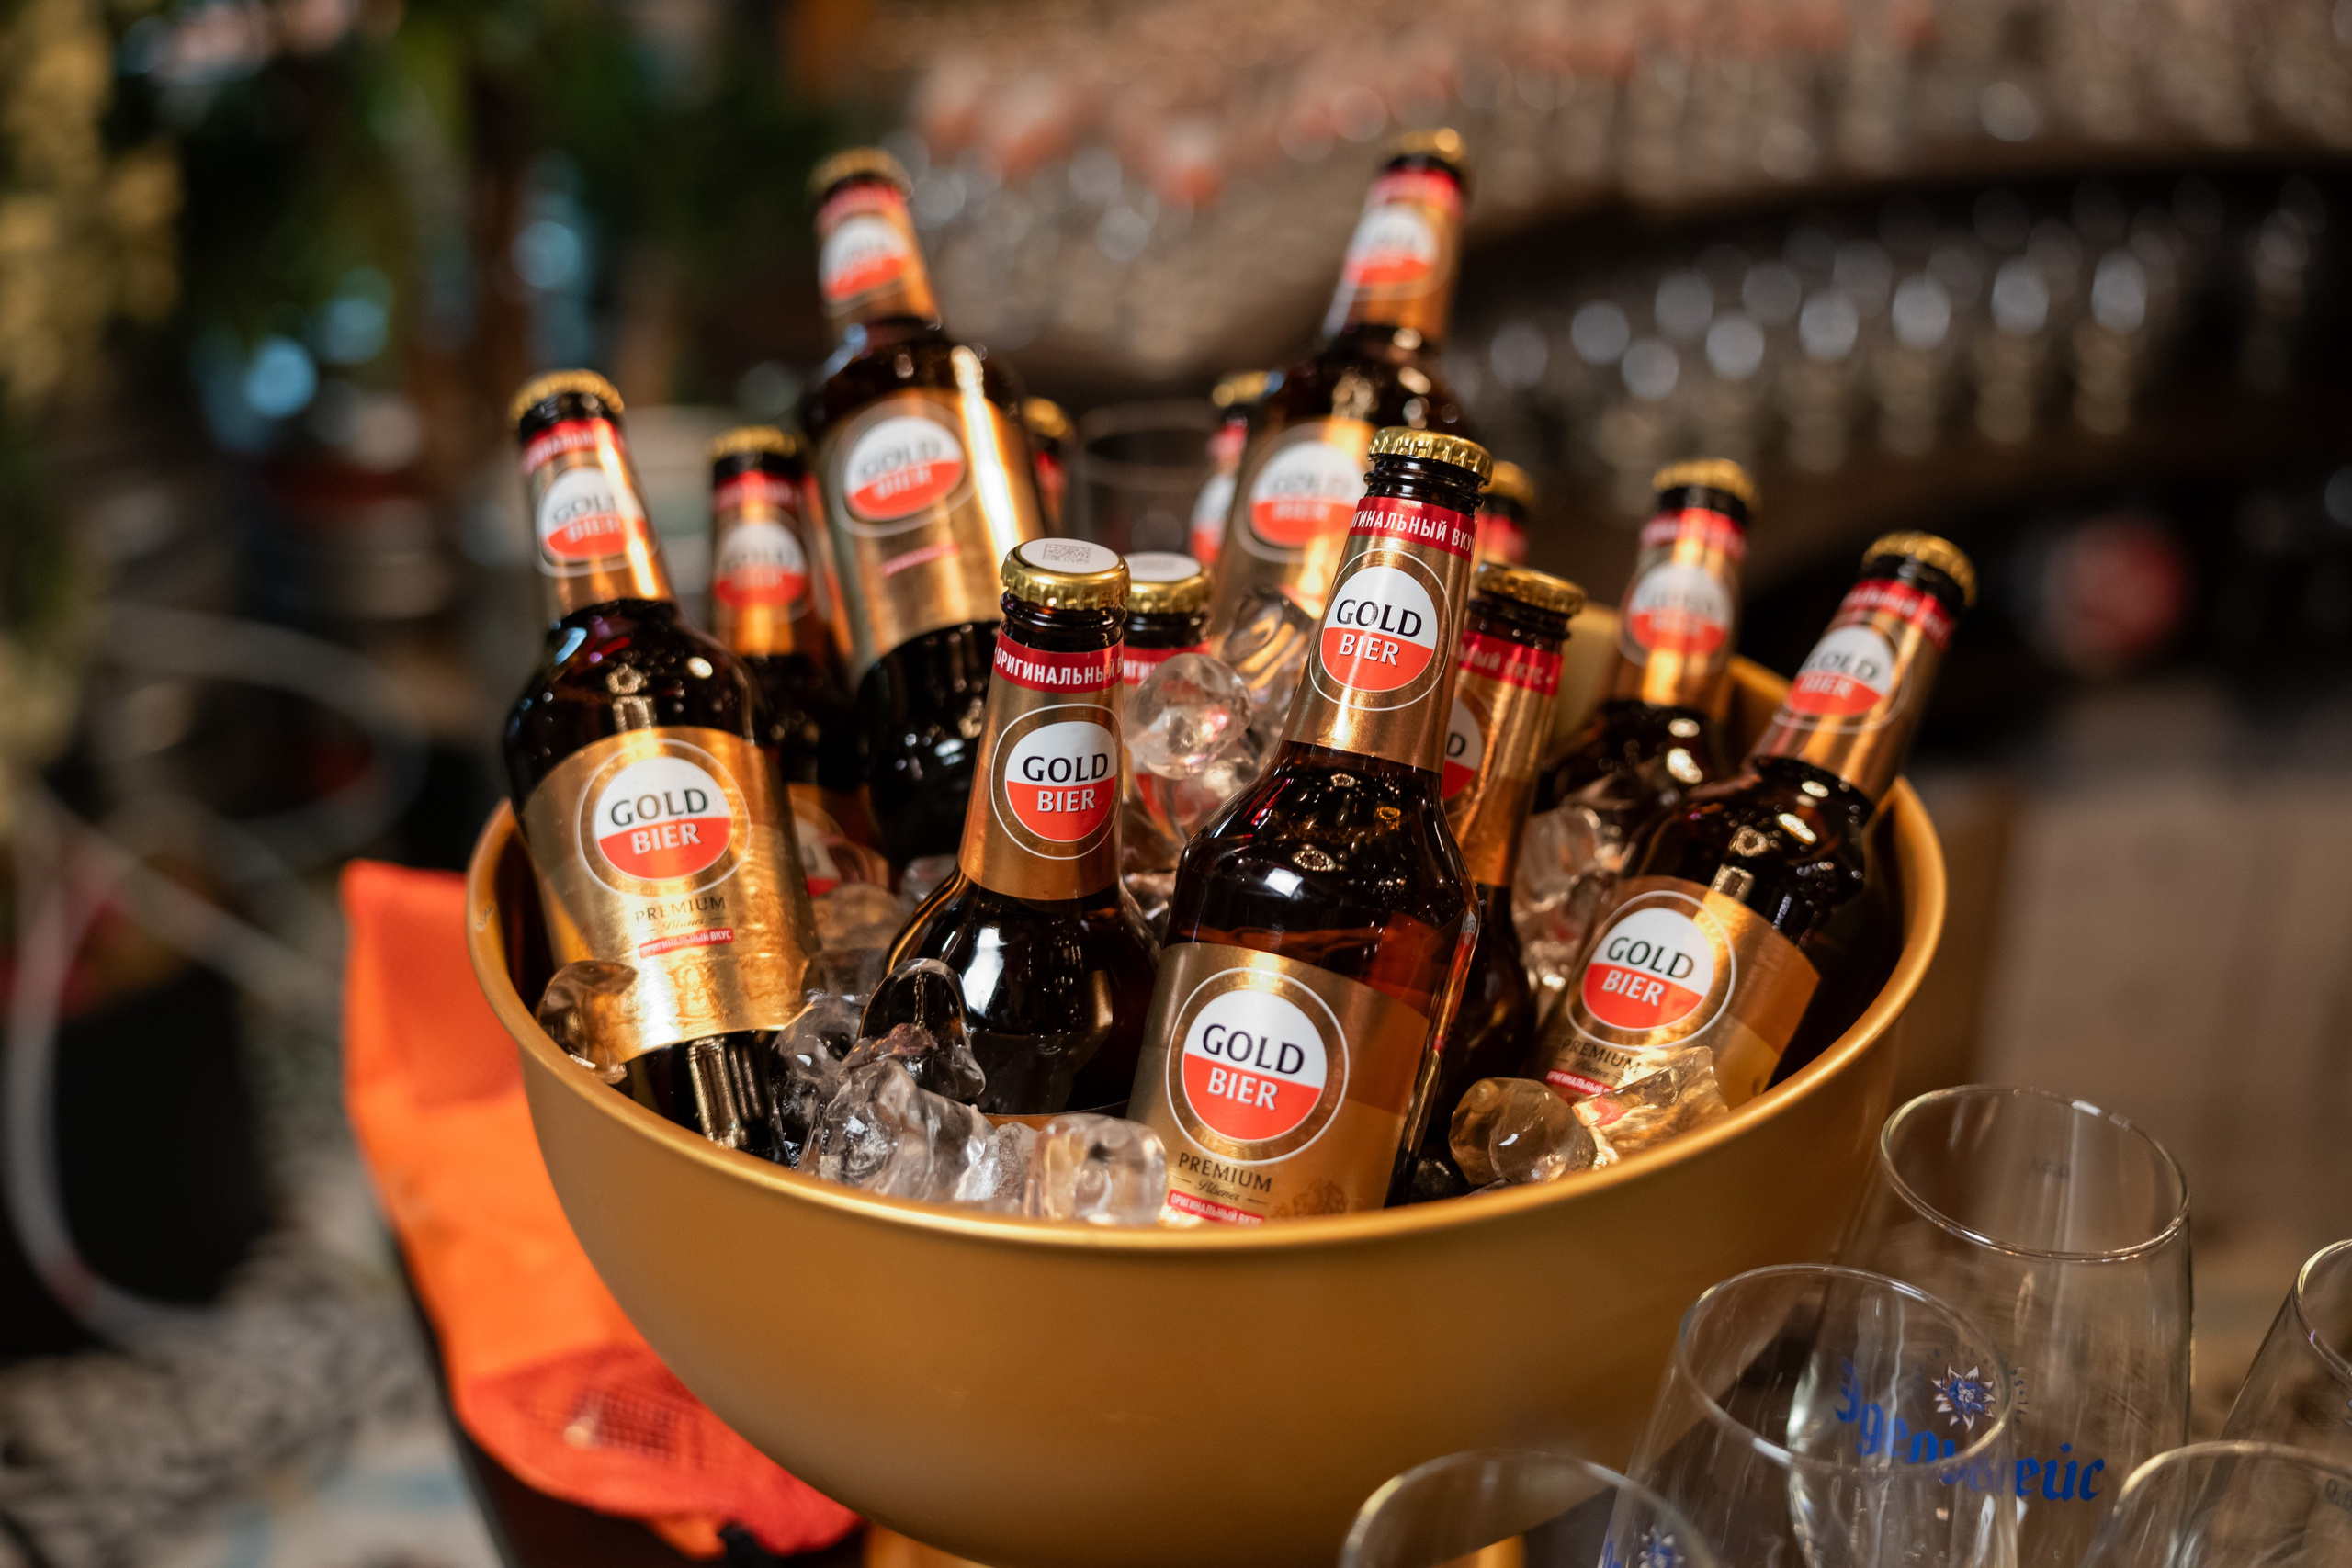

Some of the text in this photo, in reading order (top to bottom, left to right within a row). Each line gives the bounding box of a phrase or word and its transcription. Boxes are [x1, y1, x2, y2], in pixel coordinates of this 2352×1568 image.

[1351, 510, 1447, 542] ИГИНАЛЬНЫЙ
[1336, 598, 1422, 637] GOLD
[996, 647, 1114, 685] ОРИГИНАЛЬНЫЙ
[1339, 633, 1400, 667] BIER
[1023, 752, 1109, 783] GOLD
[610, 788, 709, 827] GOLD
[1037, 788, 1095, 813] BIER
[631, 822, 702, 855] BIER
[635, 897, 726, 923] PREMIUM
[710, 930, 732, 942] ВКУС
[1607, 936, 1694, 979] GOLD
[1601, 969, 1665, 1007] BIER
[1202, 1023, 1305, 1075] GOLD
[1561, 1038, 1641, 1074] PREMIUM
[1207, 1066, 1278, 1111] BIER
[1178, 1152, 1272, 1192] PREMIUM
